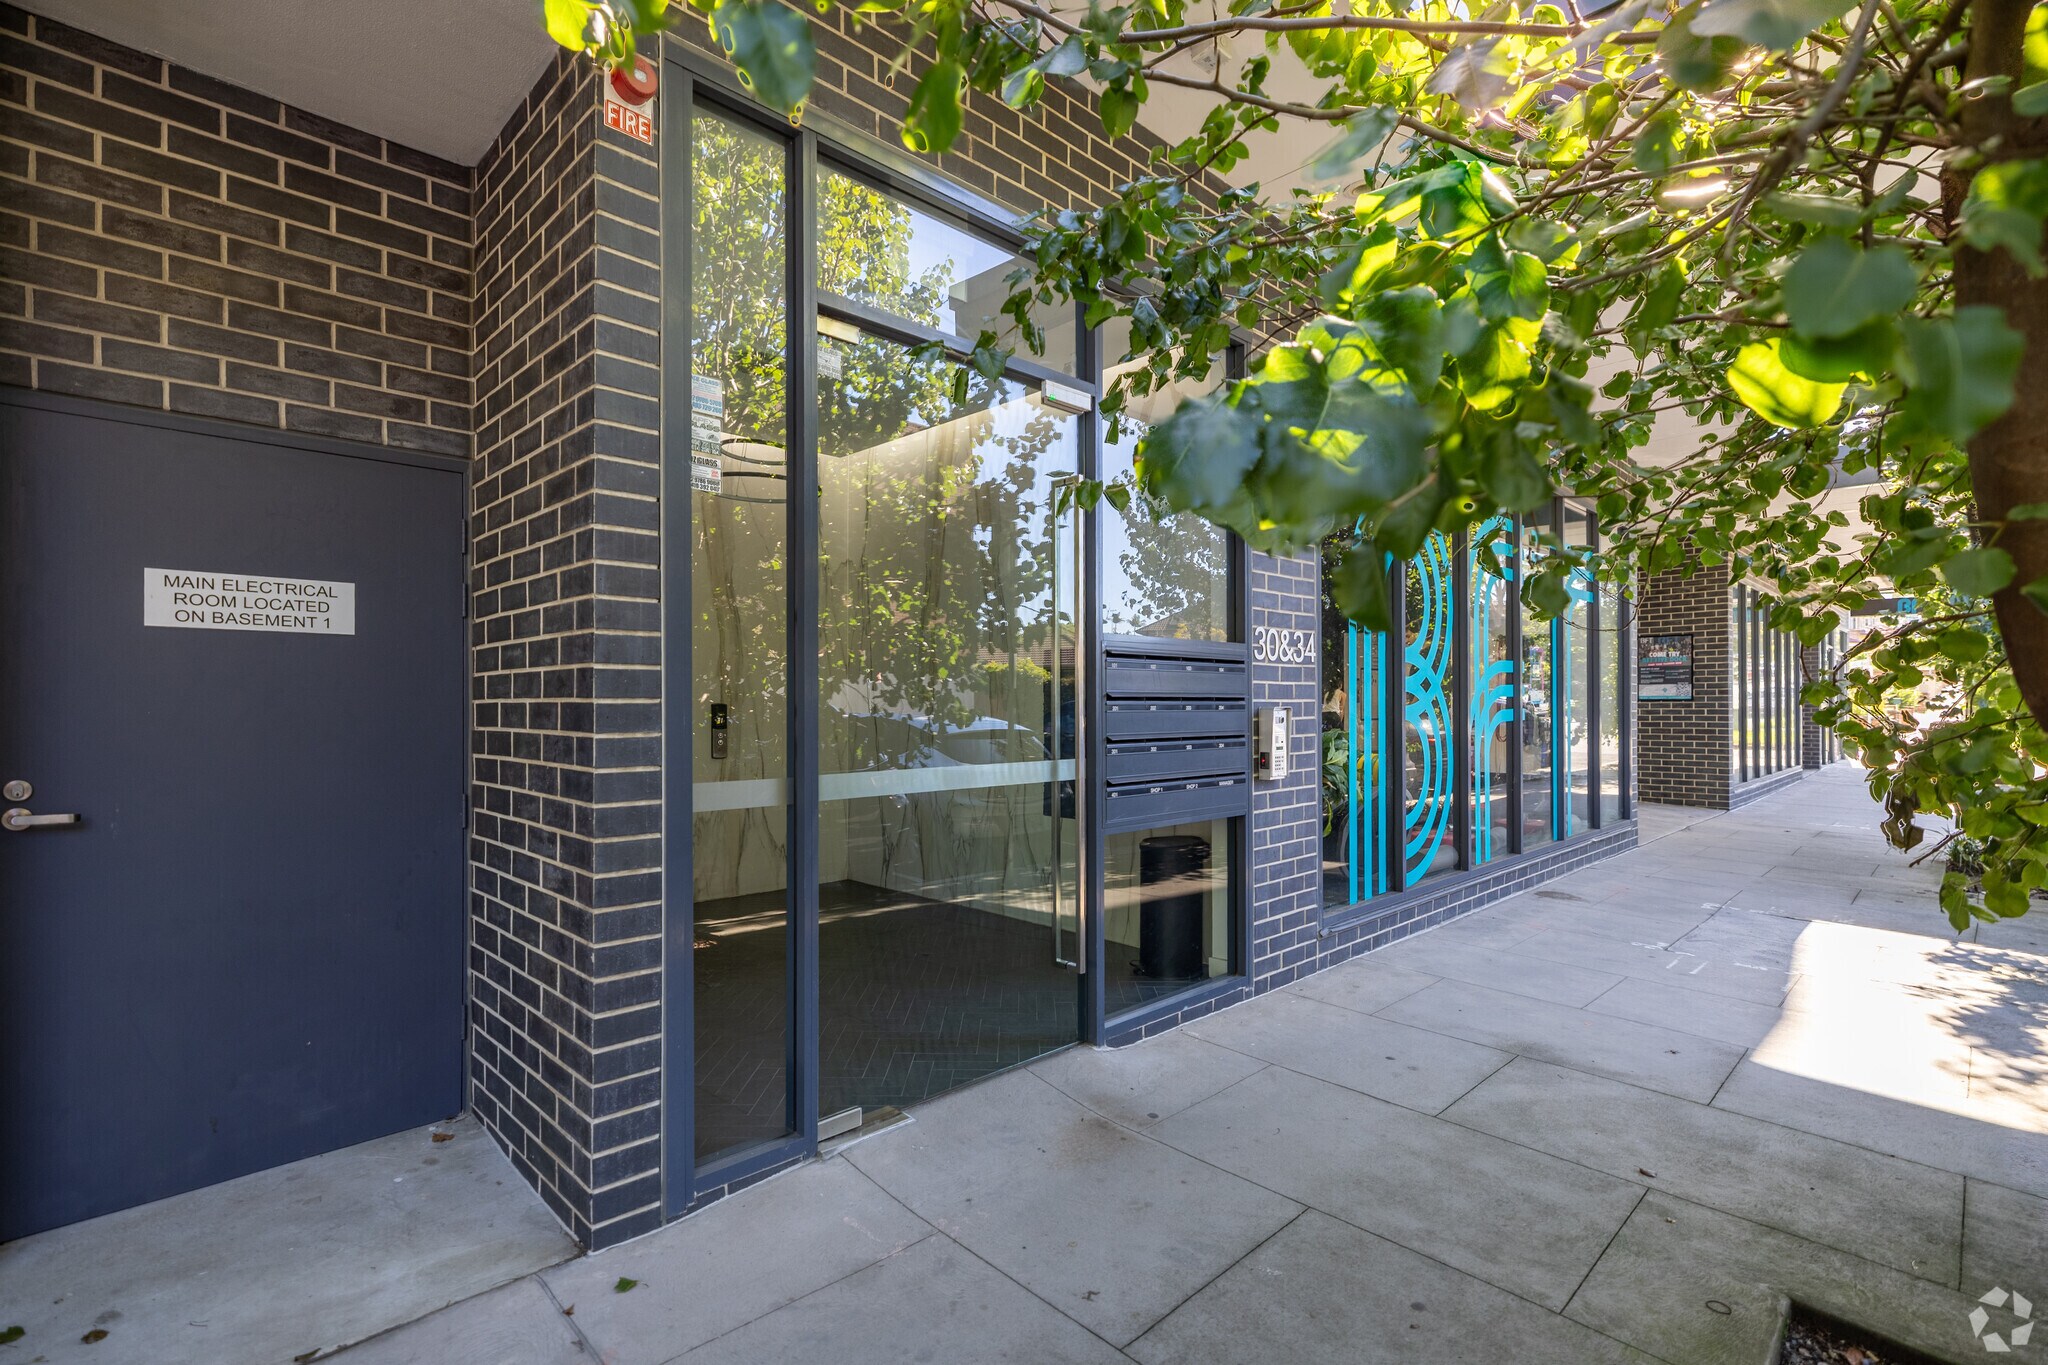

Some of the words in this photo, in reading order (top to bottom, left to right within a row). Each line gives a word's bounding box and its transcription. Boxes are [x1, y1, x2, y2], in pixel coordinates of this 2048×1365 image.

[608, 101, 650, 140] FIRE
[163, 574, 215, 590] MAIN
[222, 579, 338, 598] ELECTRICAL
[173, 592, 237, 608] ROOM
[243, 597, 330, 613] LOCATED
[174, 609, 205, 623] ON
[212, 611, 317, 628] BASEMENT
[323, 618, 330, 629] 1
[1253, 626, 1317, 663] 30&34
